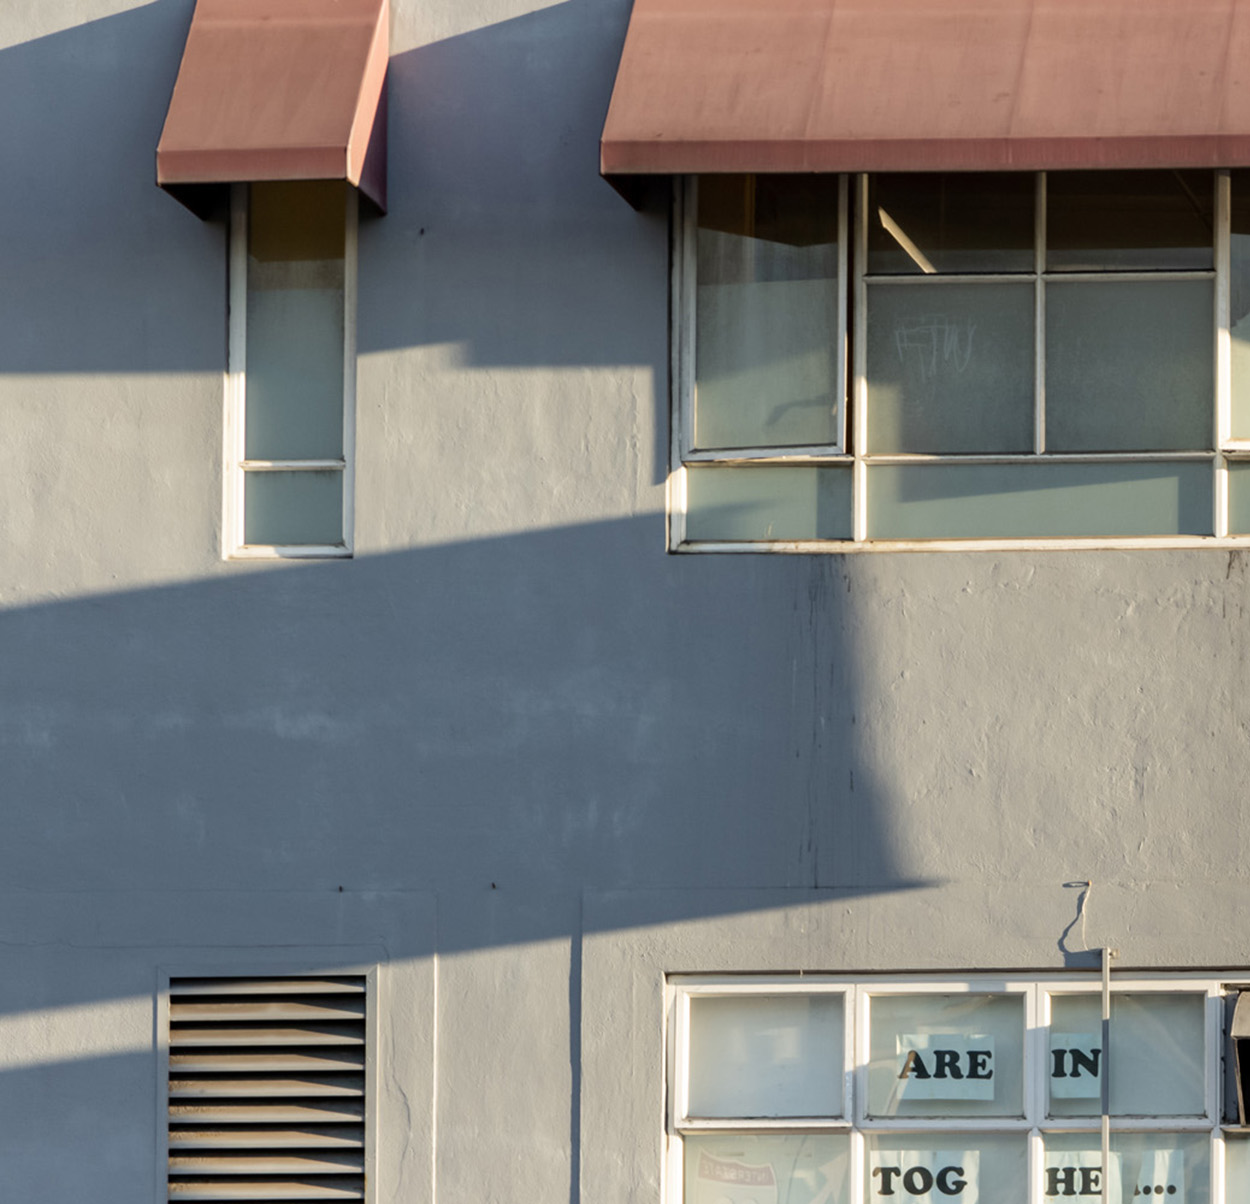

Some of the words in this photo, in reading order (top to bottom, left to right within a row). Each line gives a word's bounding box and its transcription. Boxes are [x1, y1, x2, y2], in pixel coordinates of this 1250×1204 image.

[897, 1050, 993, 1080] ARE
[1051, 1048, 1102, 1078] IN
[872, 1166, 968, 1196] TOG
